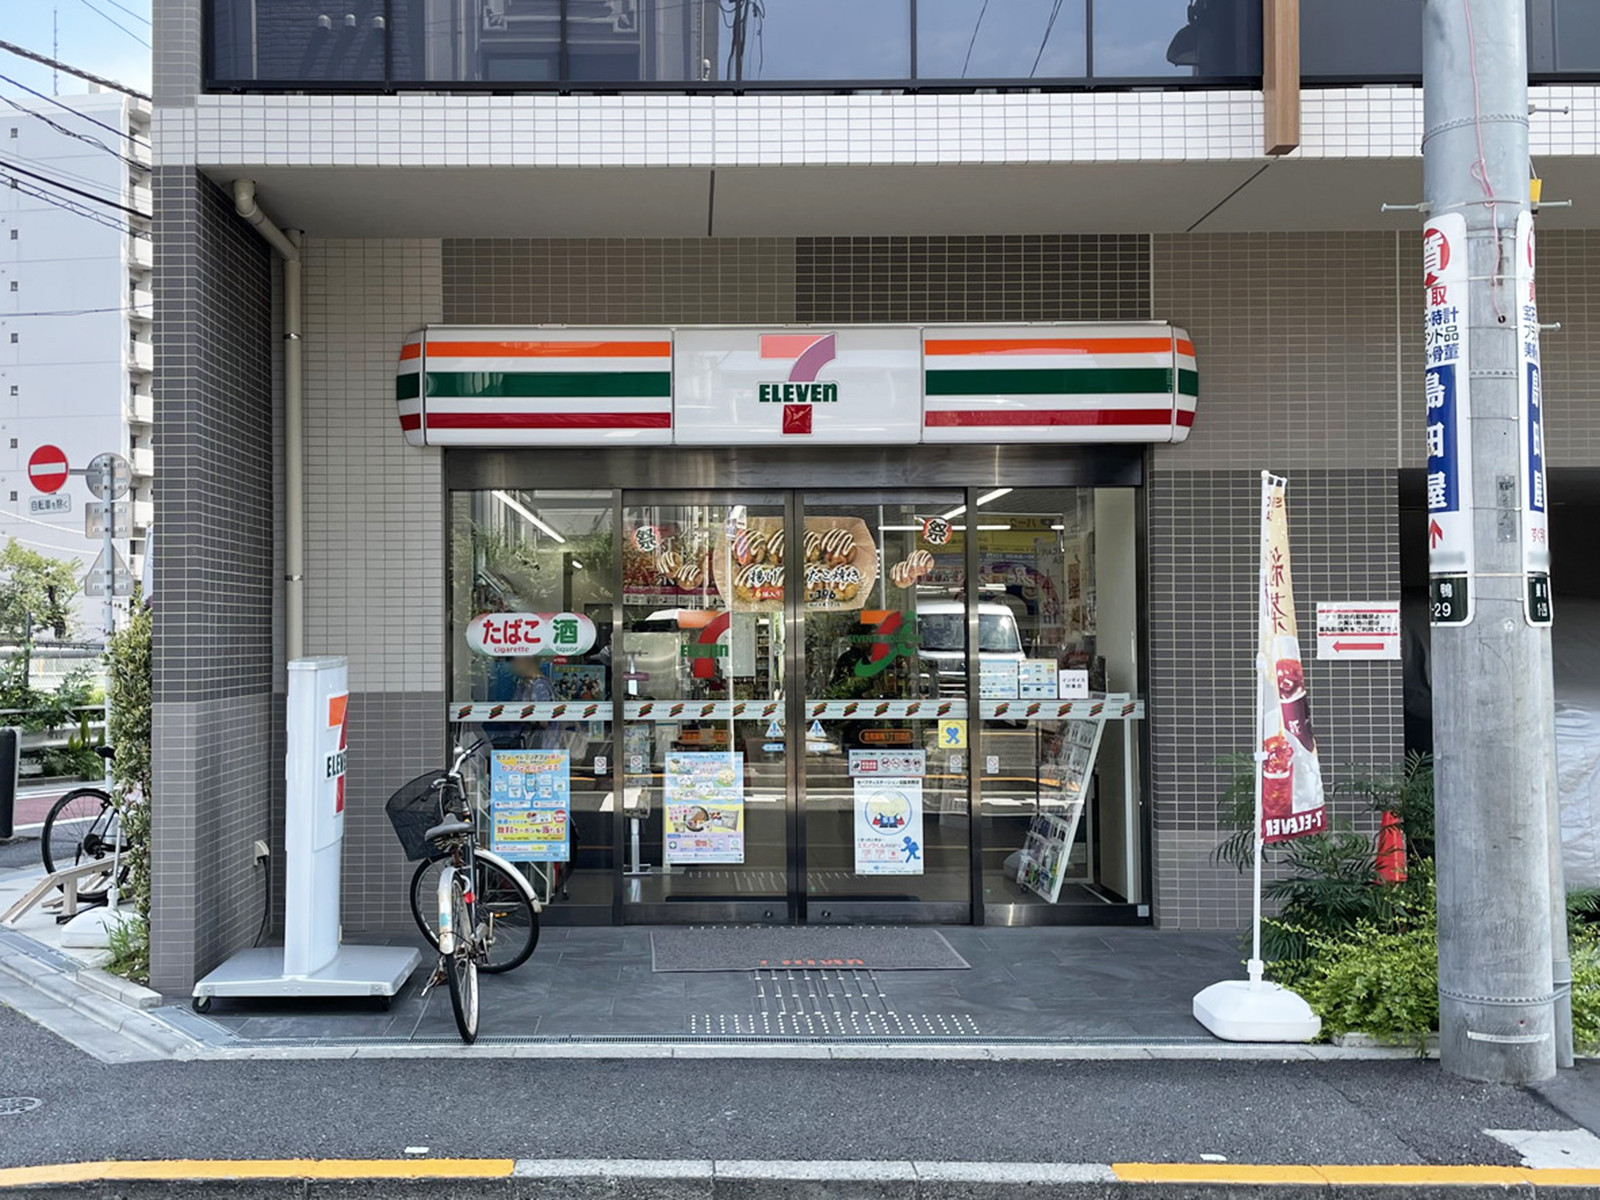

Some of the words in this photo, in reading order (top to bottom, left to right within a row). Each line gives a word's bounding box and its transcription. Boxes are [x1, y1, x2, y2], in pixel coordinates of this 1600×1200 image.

[482, 619, 542, 645] たばこ
[552, 619, 579, 645] 酒
